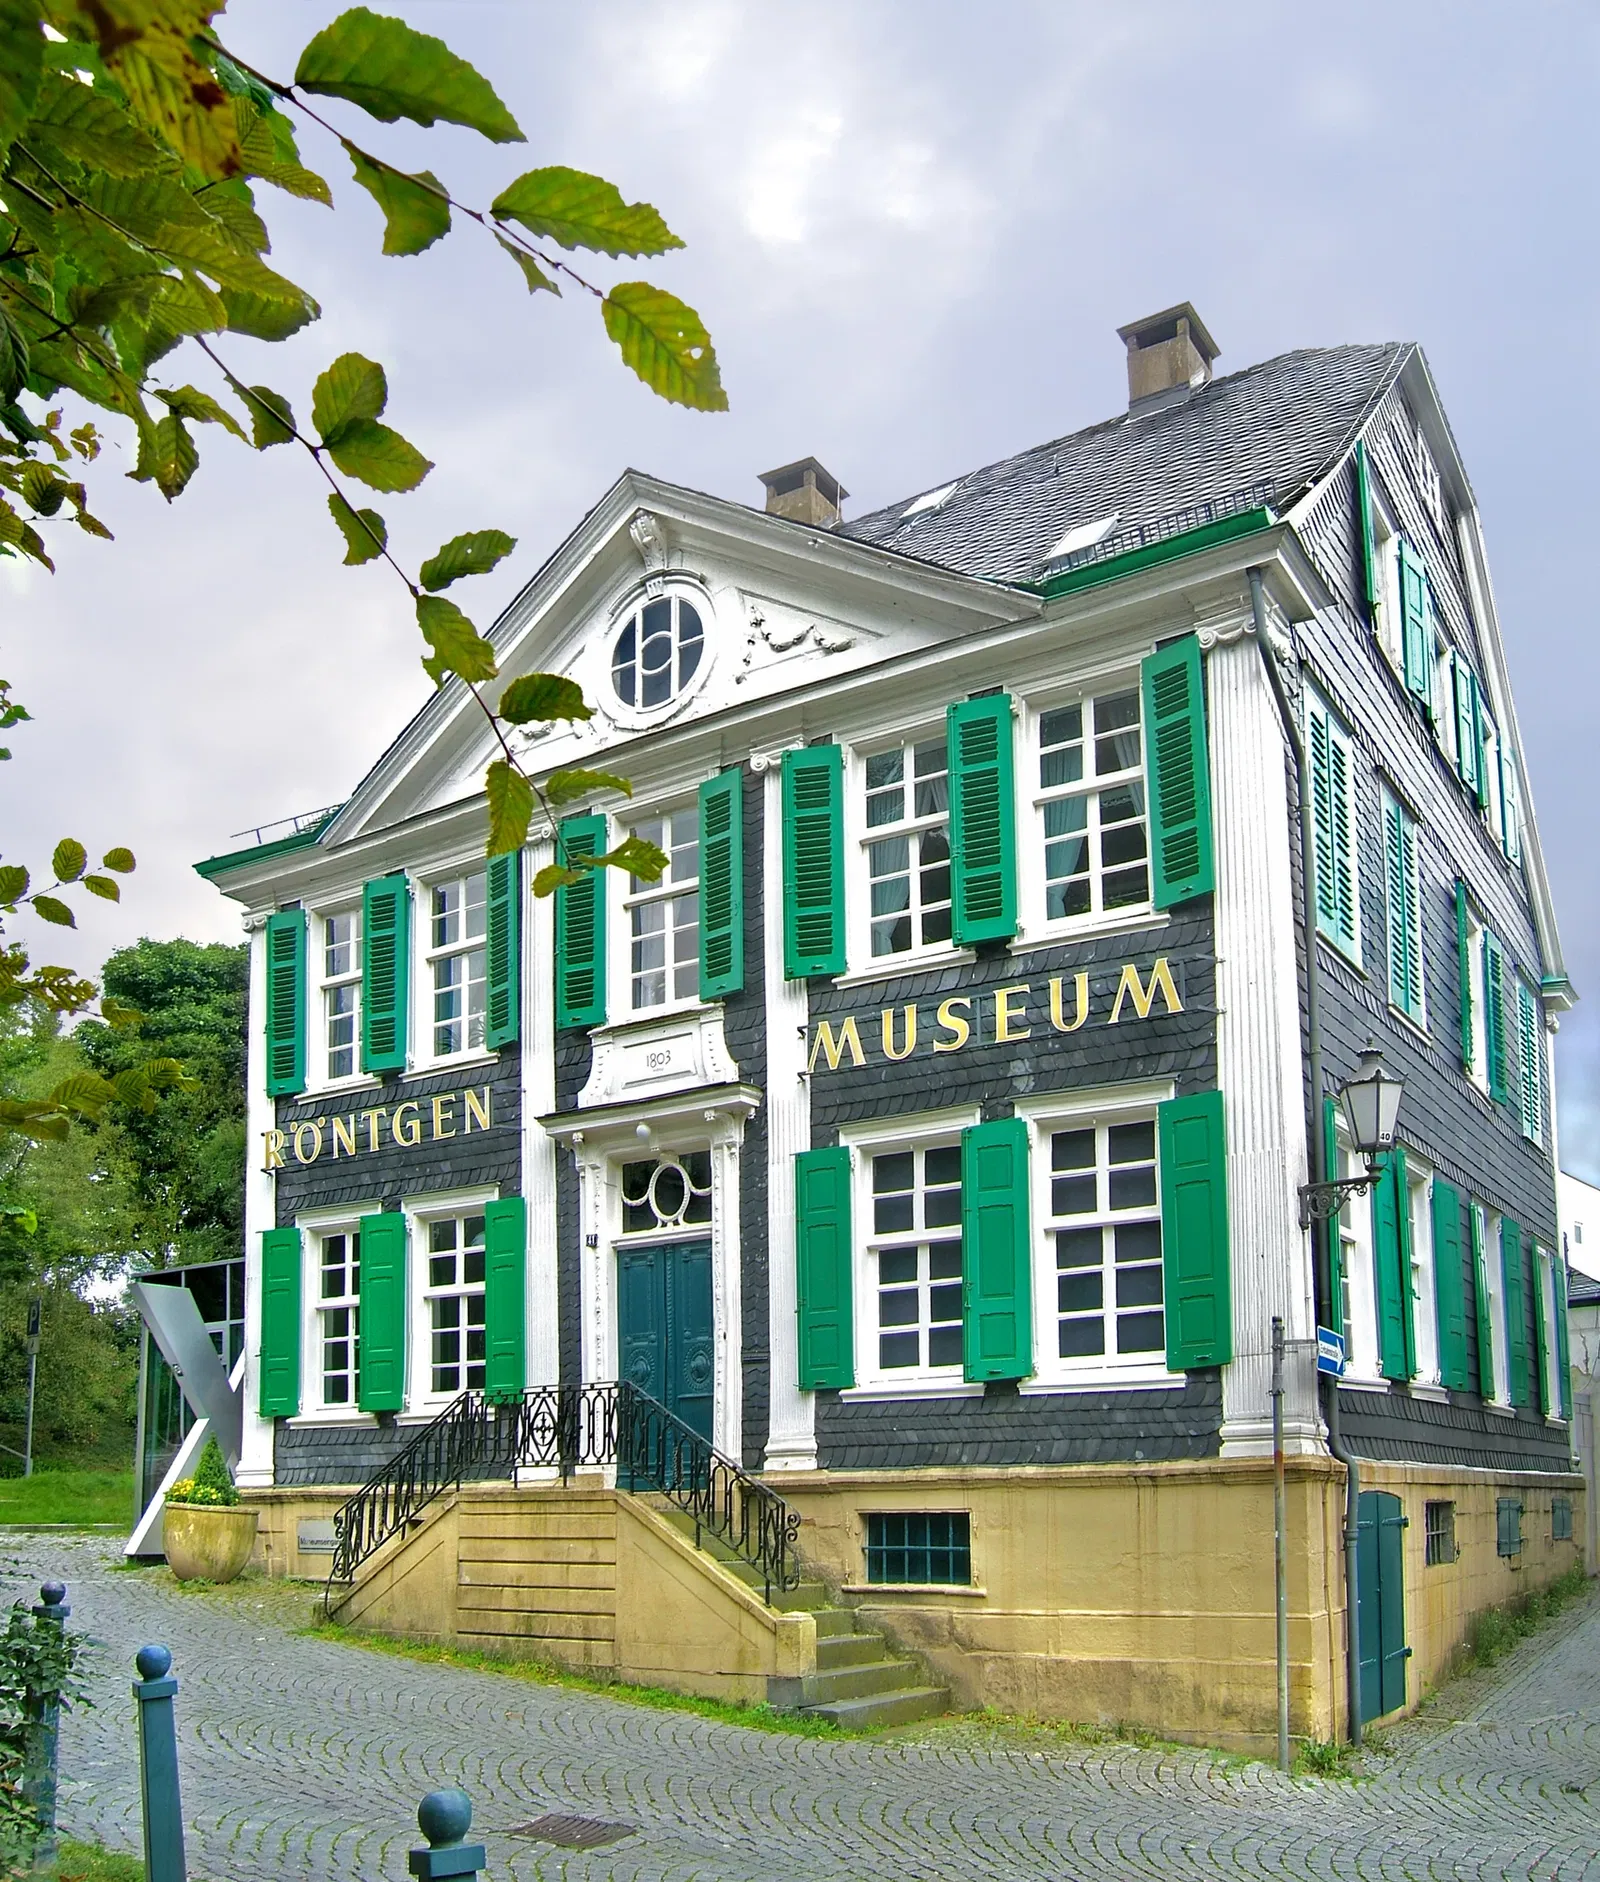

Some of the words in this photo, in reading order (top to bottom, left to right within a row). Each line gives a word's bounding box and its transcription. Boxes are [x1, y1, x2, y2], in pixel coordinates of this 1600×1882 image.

[807, 957, 1185, 1073] MUSEUM
[646, 1049, 672, 1069] 1803
[264, 1085, 492, 1170] RÖNTGEN
[1380, 1132, 1391, 1141] 40
[29, 1305, 38, 1332] P
